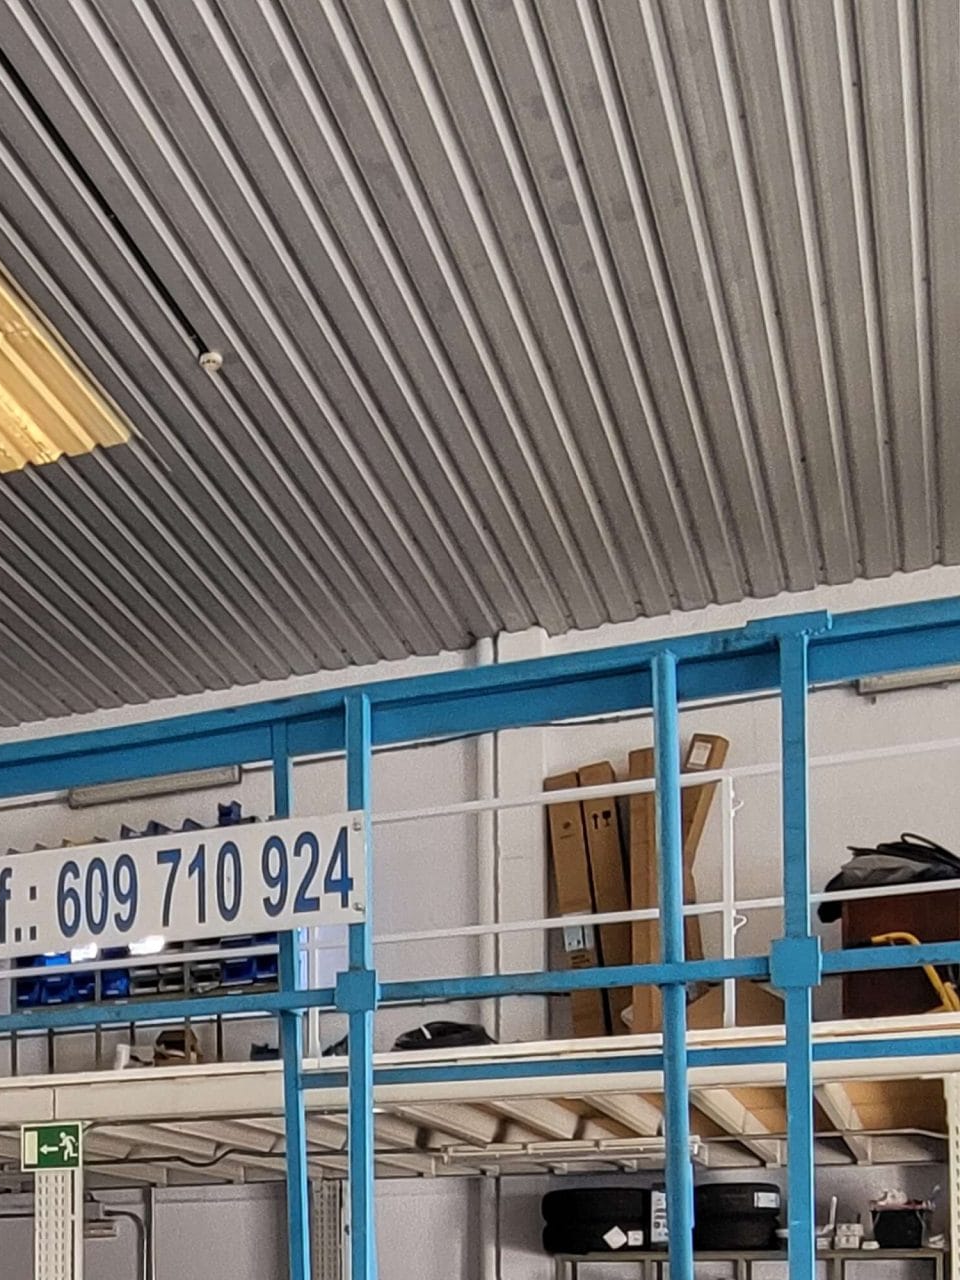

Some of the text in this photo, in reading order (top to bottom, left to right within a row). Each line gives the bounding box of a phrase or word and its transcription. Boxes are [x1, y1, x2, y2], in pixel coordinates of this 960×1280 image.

[57, 854, 138, 938] 609
[157, 841, 242, 927] 710
[262, 826, 354, 917] 924
